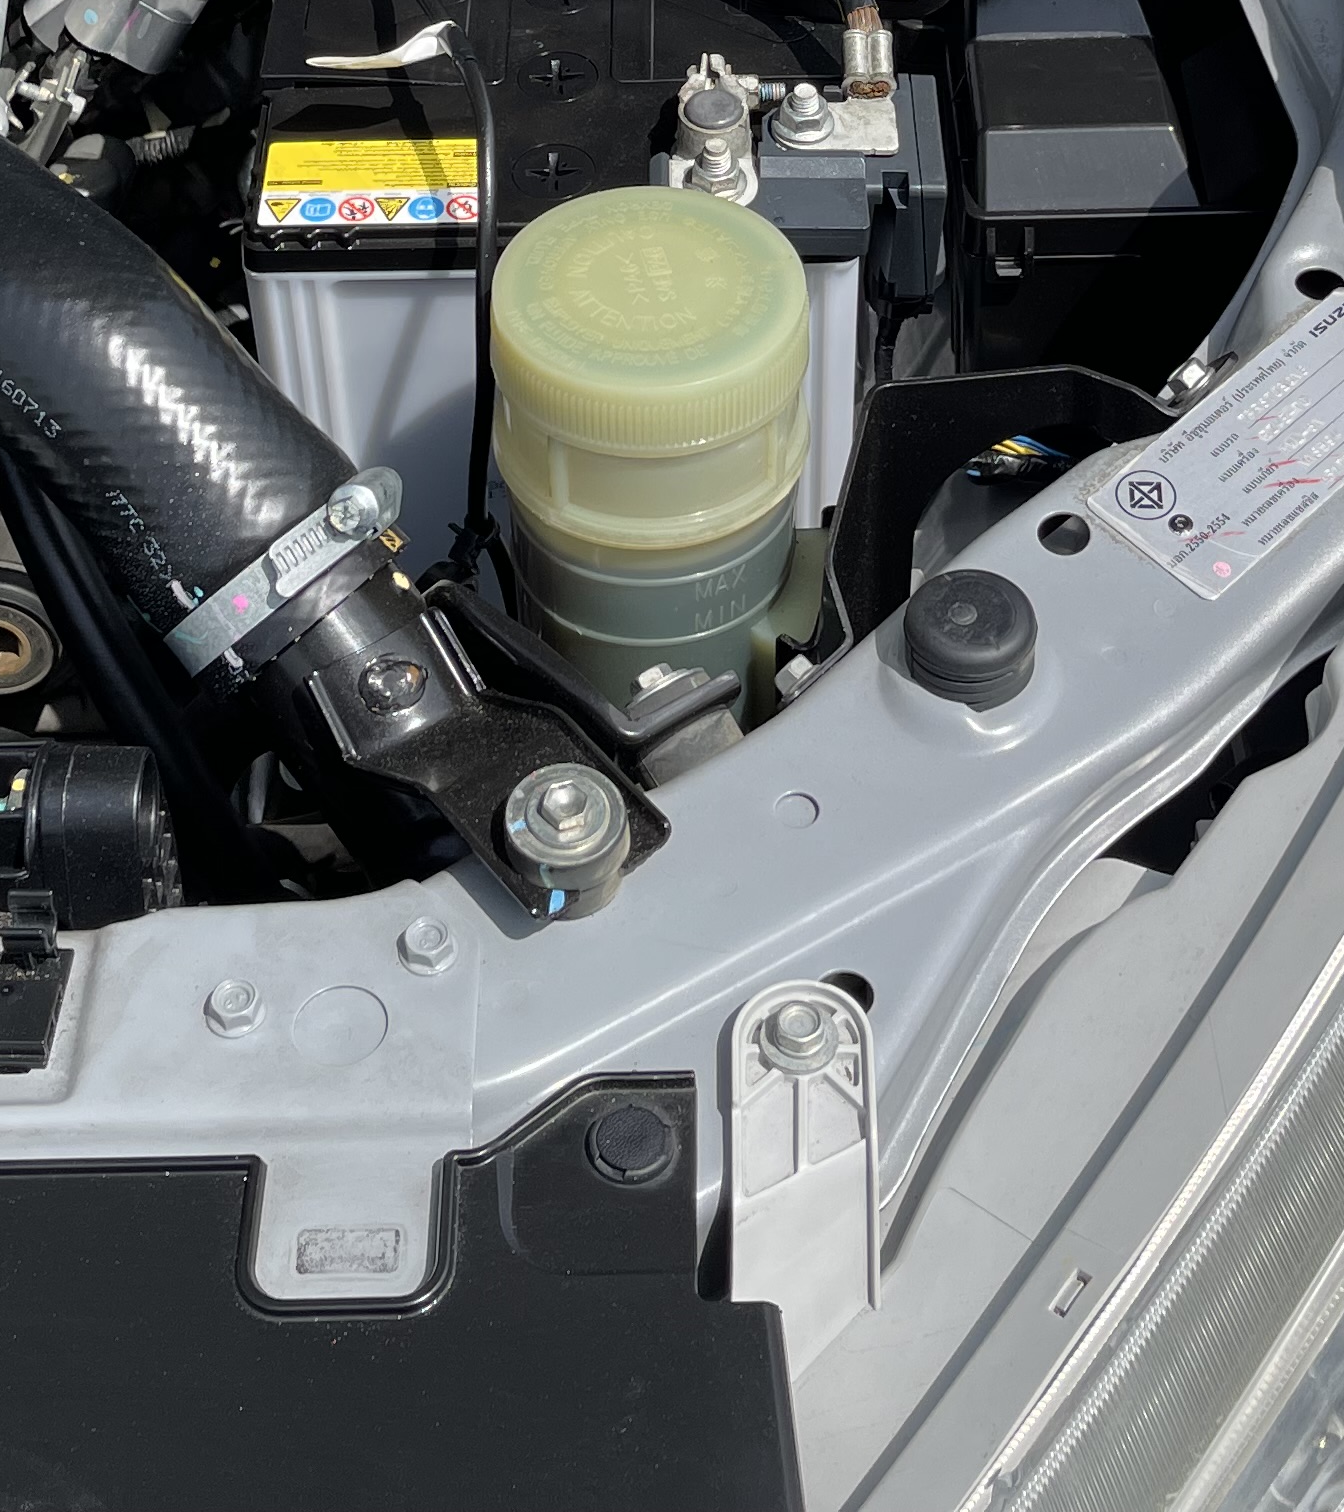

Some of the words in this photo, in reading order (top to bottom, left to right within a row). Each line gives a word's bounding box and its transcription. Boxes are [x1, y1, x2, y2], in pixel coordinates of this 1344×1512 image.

[568, 289, 698, 331] ATTENTION
[1159, 439, 1185, 464] บริษัท
[1233, 358, 1287, 404] (ประเทศไทย)
[1283, 339, 1308, 359] จำกัด
[1217, 447, 1261, 483] แบบเครื่อง
[1165, 512, 1231, 570] มอก.2550-2554
[695, 564, 746, 602] MAX
[695, 593, 746, 632] MIN
